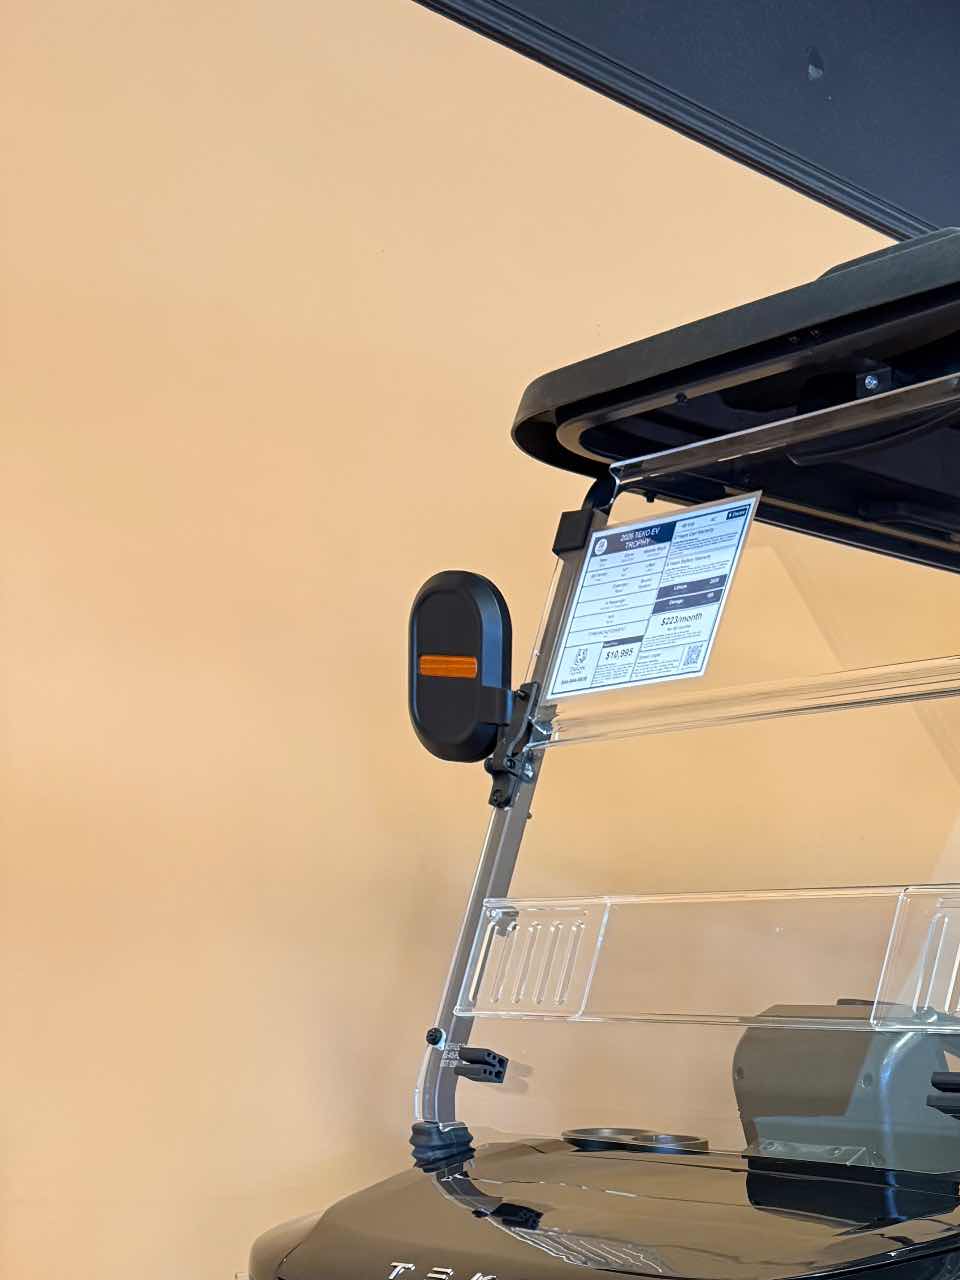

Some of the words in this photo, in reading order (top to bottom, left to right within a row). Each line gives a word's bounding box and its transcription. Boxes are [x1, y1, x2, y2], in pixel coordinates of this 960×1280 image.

[635, 529, 651, 539] TEKO
[651, 527, 661, 536] EV
[661, 612, 703, 627] $223/month
